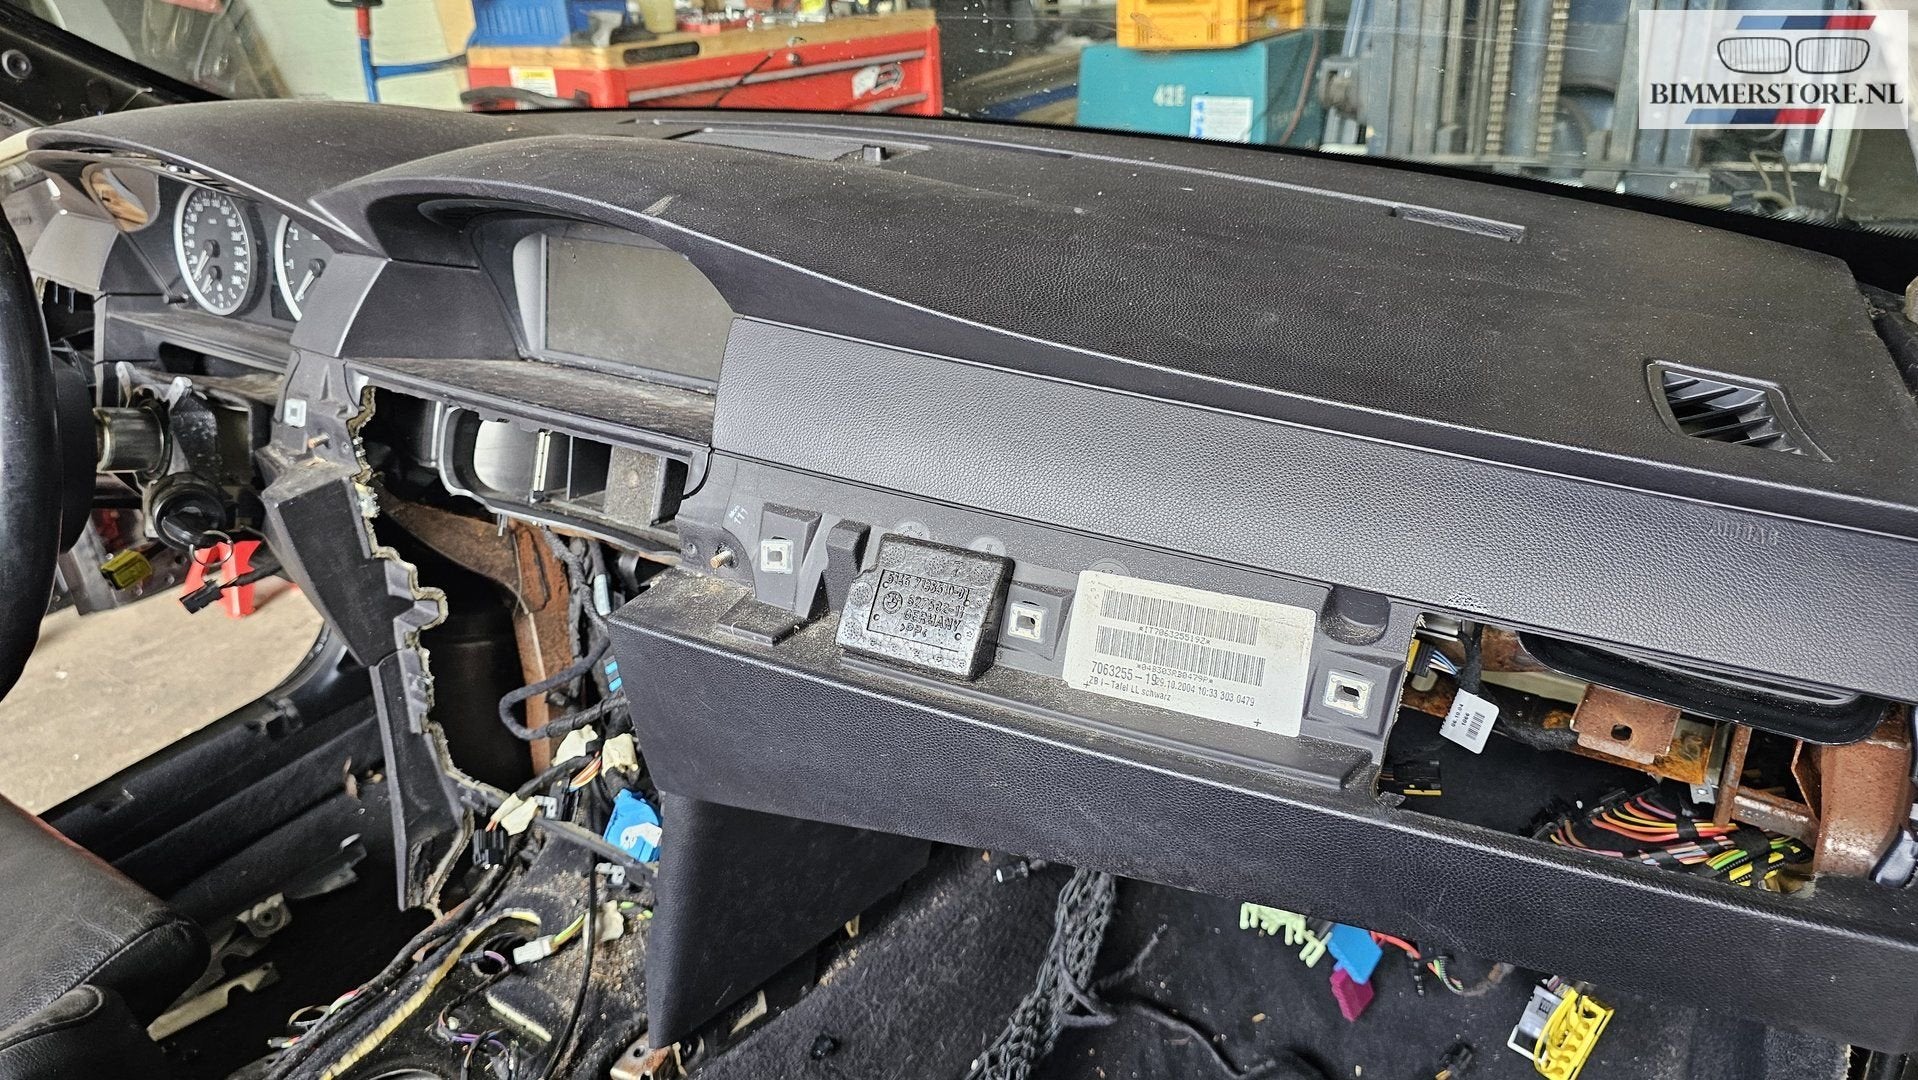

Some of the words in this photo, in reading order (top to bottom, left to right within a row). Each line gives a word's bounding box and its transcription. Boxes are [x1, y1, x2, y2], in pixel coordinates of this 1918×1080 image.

[904, 608, 962, 632] GERMANY
[1130, 685, 1140, 695] LL
[1141, 688, 1172, 701] schwarz
[1198, 686, 1218, 699] 10:33
[1220, 691, 1234, 702] 303
[1236, 694, 1255, 707] 0479
